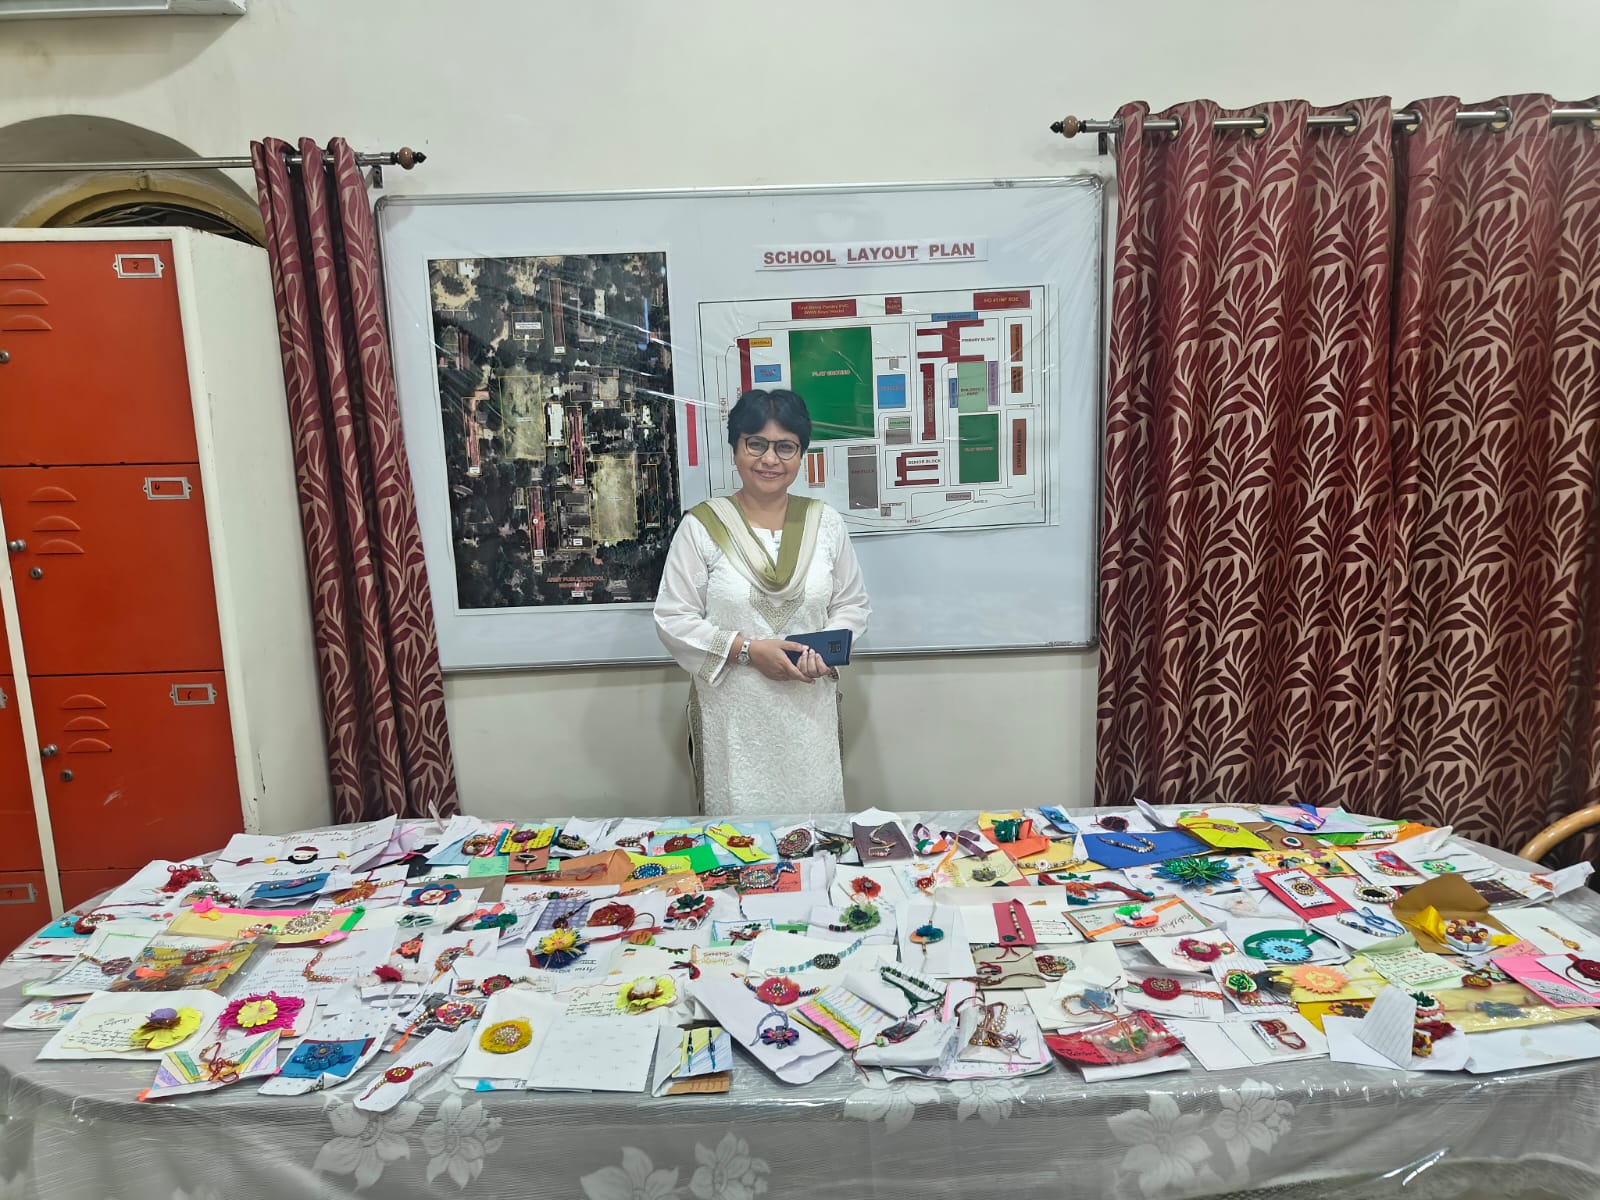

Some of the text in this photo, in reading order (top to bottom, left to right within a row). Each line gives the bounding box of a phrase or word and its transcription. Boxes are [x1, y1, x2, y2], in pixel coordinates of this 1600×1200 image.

[764, 242, 976, 264] SCHOOL LAYOUT PLAN
